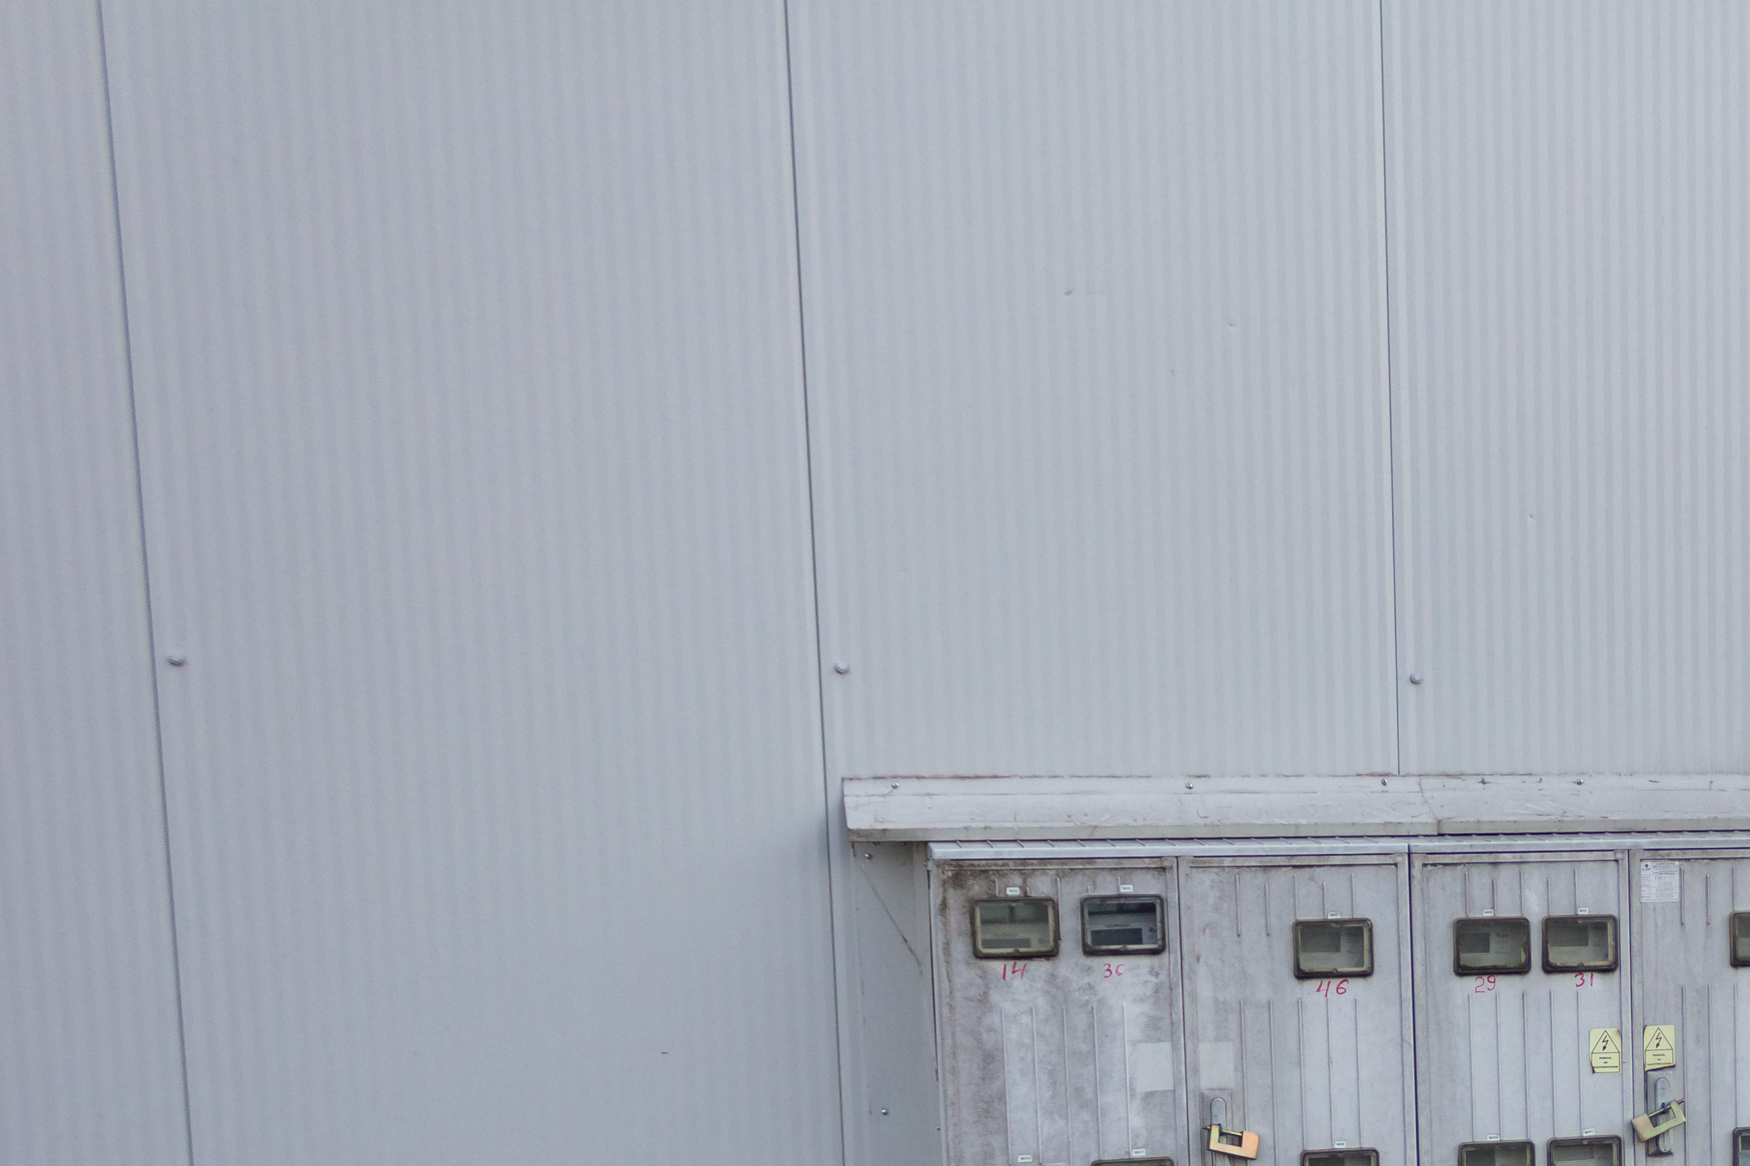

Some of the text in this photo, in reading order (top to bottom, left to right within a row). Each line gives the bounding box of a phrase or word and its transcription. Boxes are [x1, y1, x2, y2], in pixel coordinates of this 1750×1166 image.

[1002, 961, 1028, 981] 14
[1574, 972, 1594, 988] 31
[1316, 978, 1350, 999] 46
[1474, 974, 1497, 994] 29
